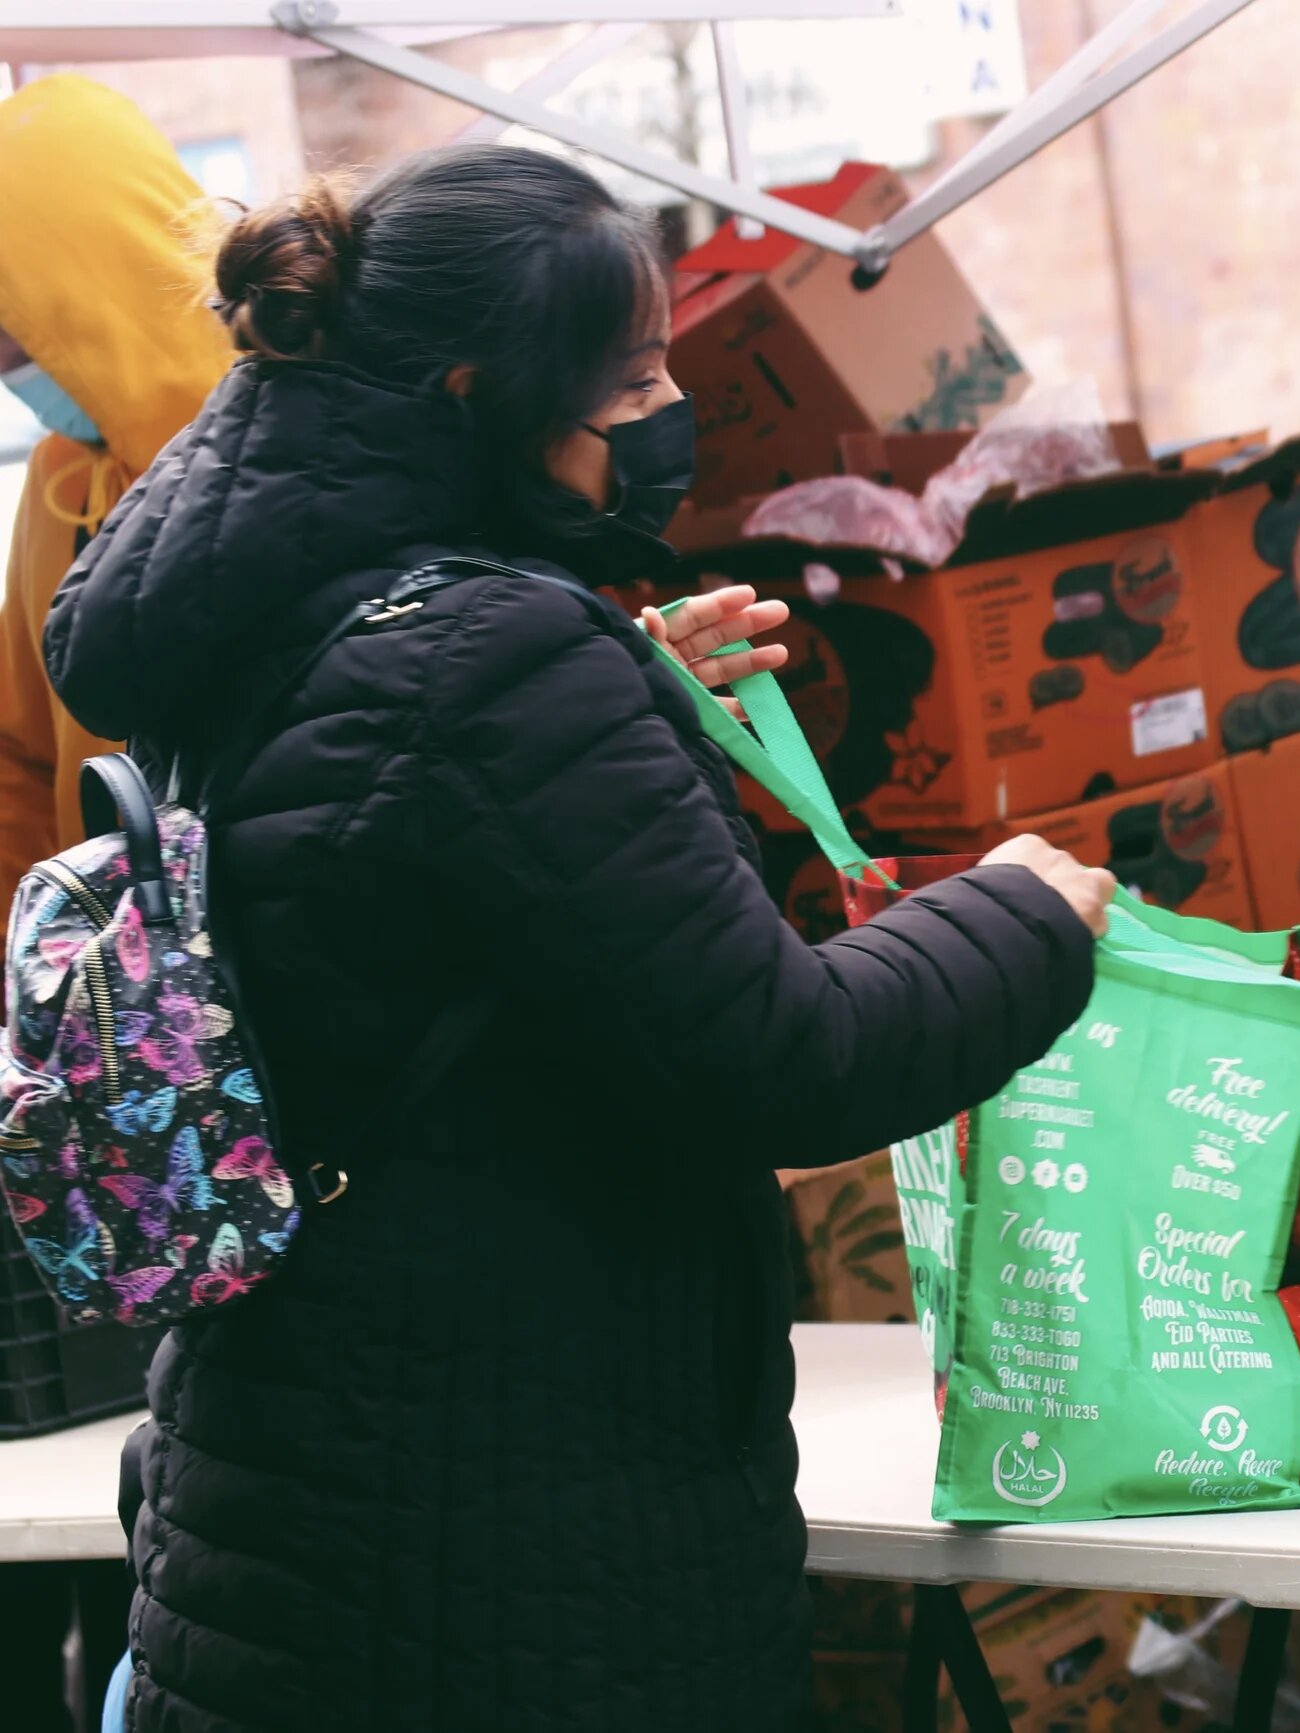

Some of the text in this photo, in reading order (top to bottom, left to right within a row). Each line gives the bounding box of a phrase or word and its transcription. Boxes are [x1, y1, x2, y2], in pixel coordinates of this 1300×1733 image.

[1206, 1057, 1264, 1098] Free
[1000, 1209, 1021, 1243] 7
[1018, 1216, 1082, 1268] days
[1155, 1212, 1246, 1259] Special
[1000, 1258, 1090, 1303] a week
[1137, 1246, 1254, 1303] Orders for
[1165, 1321, 1254, 1345] EID PARTIES
[990, 1345, 1009, 1362] 713
[1152, 1344, 1273, 1374] AND ALL CATERING
[997, 1366, 1041, 1391] BEACH
[1065, 1405, 1099, 1420] 11235
[1000, 1450, 1057, 1481] حلال
[1011, 1483, 1045, 1493] HALAL
